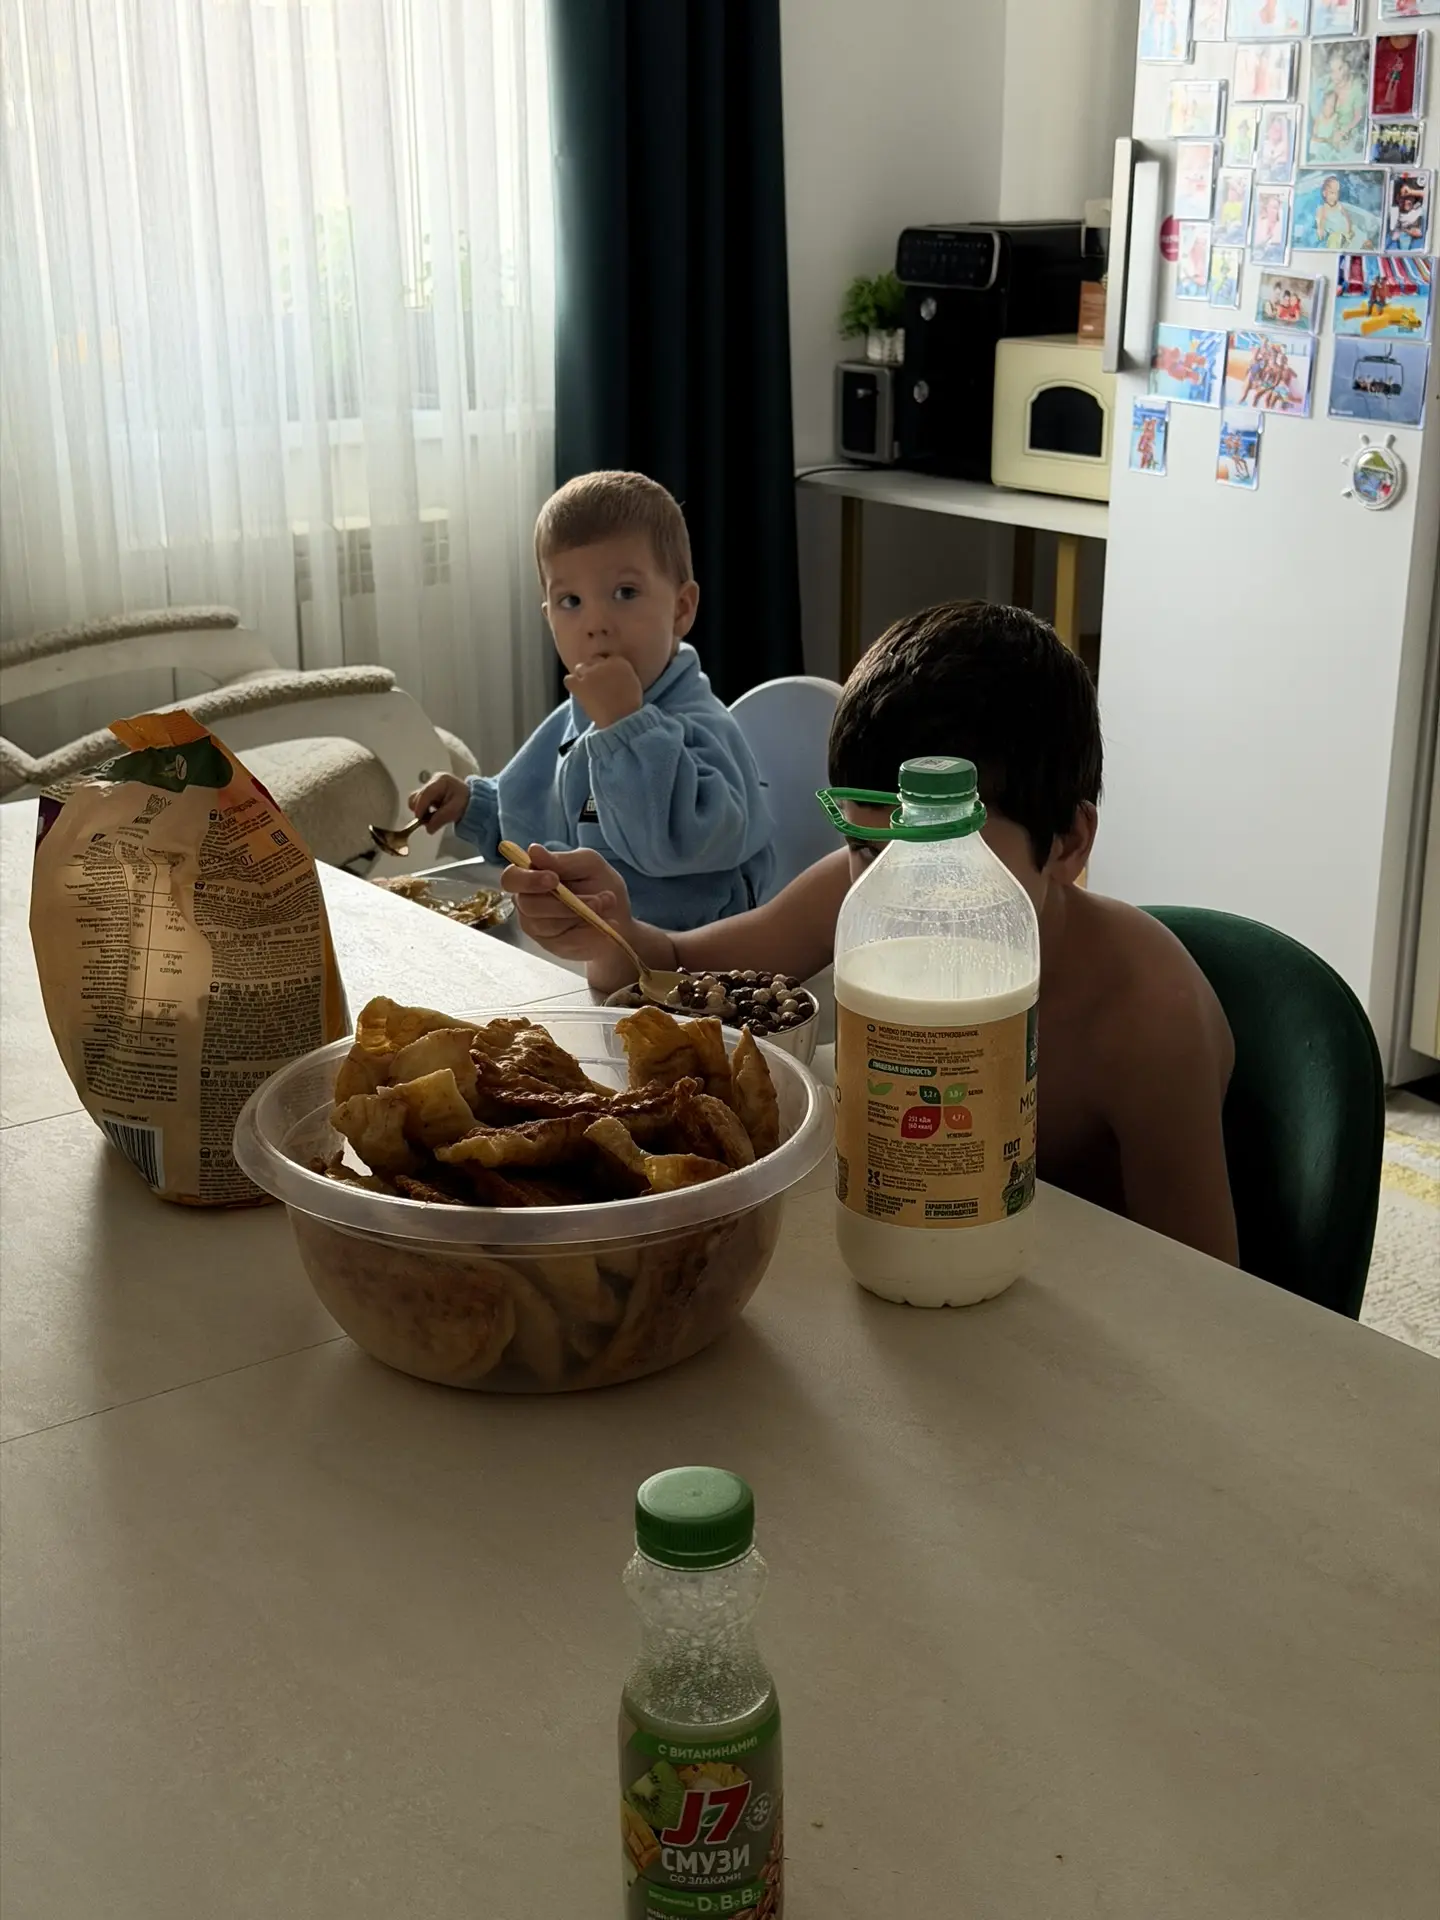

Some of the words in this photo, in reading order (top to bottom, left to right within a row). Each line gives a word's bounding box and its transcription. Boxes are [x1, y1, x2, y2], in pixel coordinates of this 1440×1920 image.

[872, 1061, 899, 1073] ПИЩЕВАЯ
[900, 1065, 932, 1076] ЦЕННОСТЬ
[1003, 1137, 1021, 1156] ГОСТ
[657, 1744, 668, 1755] С
[660, 1780, 753, 1848] J7
[661, 1843, 750, 1875] СМУЗИ
[669, 1873, 686, 1884] СО
[688, 1872, 741, 1885] ЗЛАКАМИ
